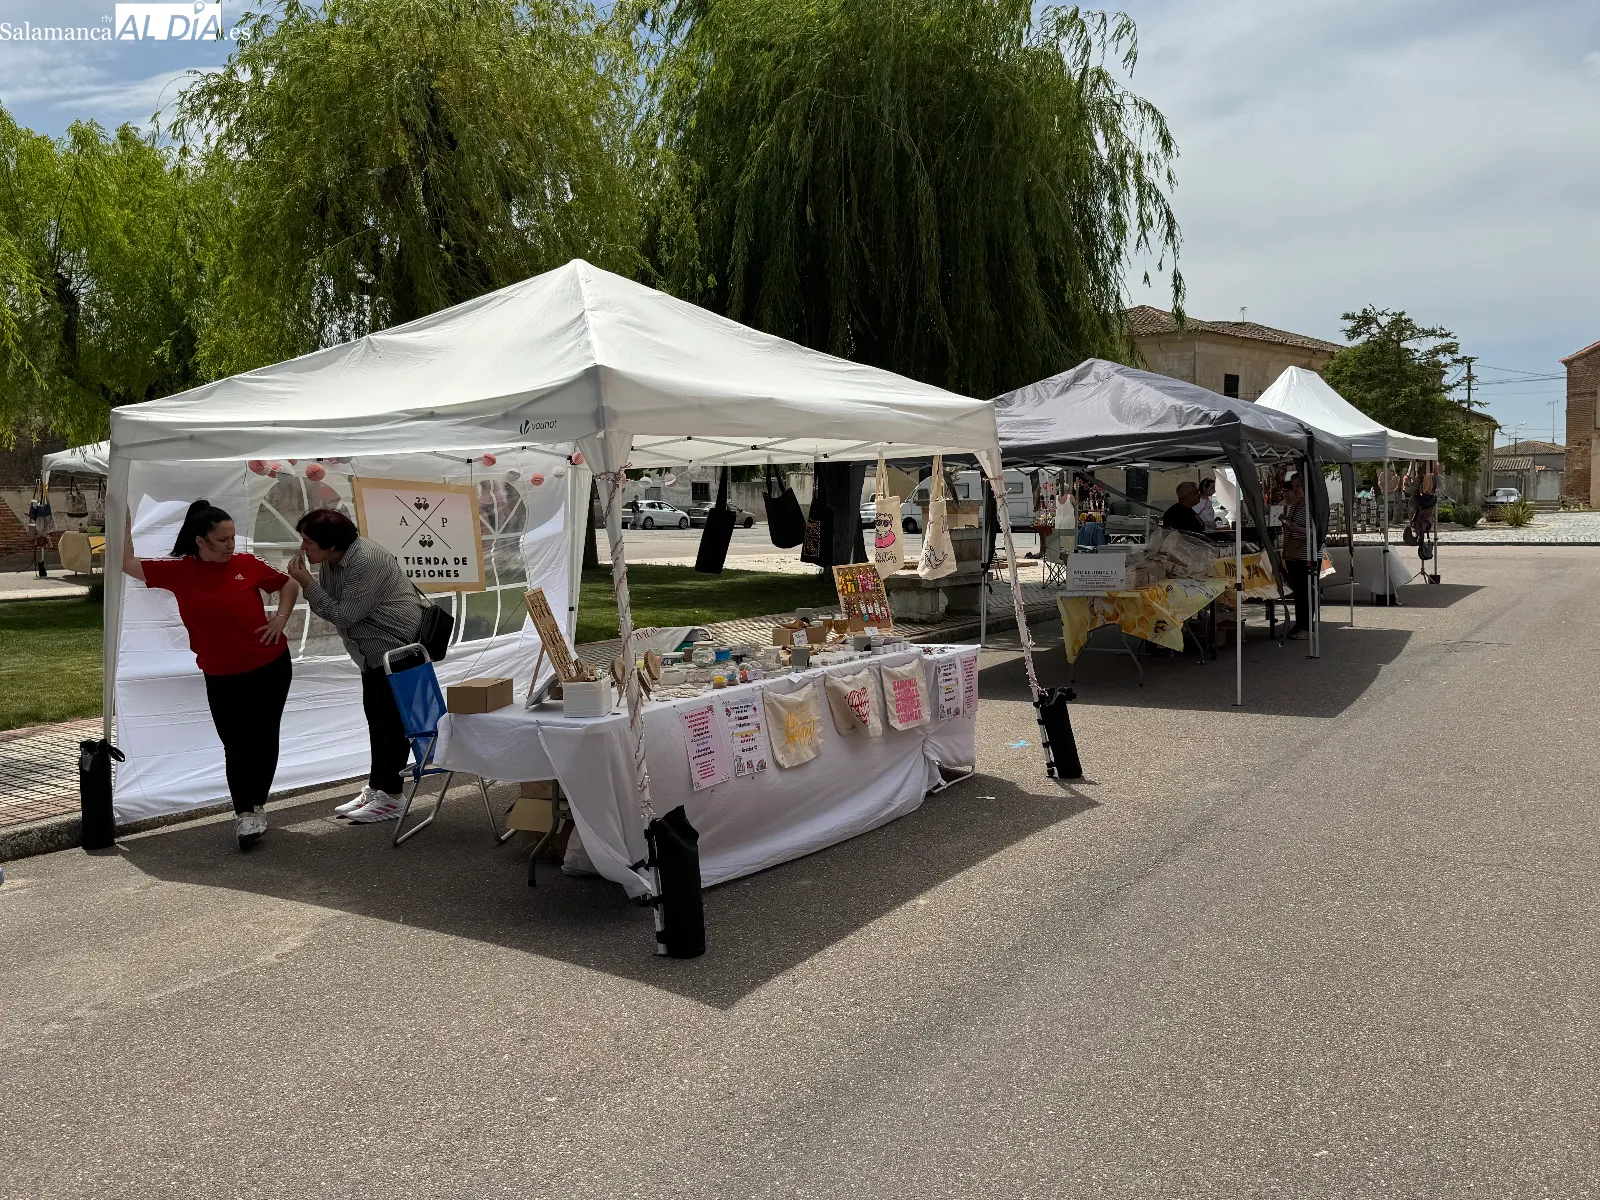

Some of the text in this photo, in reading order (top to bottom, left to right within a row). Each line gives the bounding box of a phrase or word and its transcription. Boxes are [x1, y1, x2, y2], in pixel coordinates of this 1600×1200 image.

[399, 516, 448, 528] A P
[404, 556, 448, 566] TIENDA
[454, 557, 468, 566] DE
[406, 569, 460, 579] USIONES
